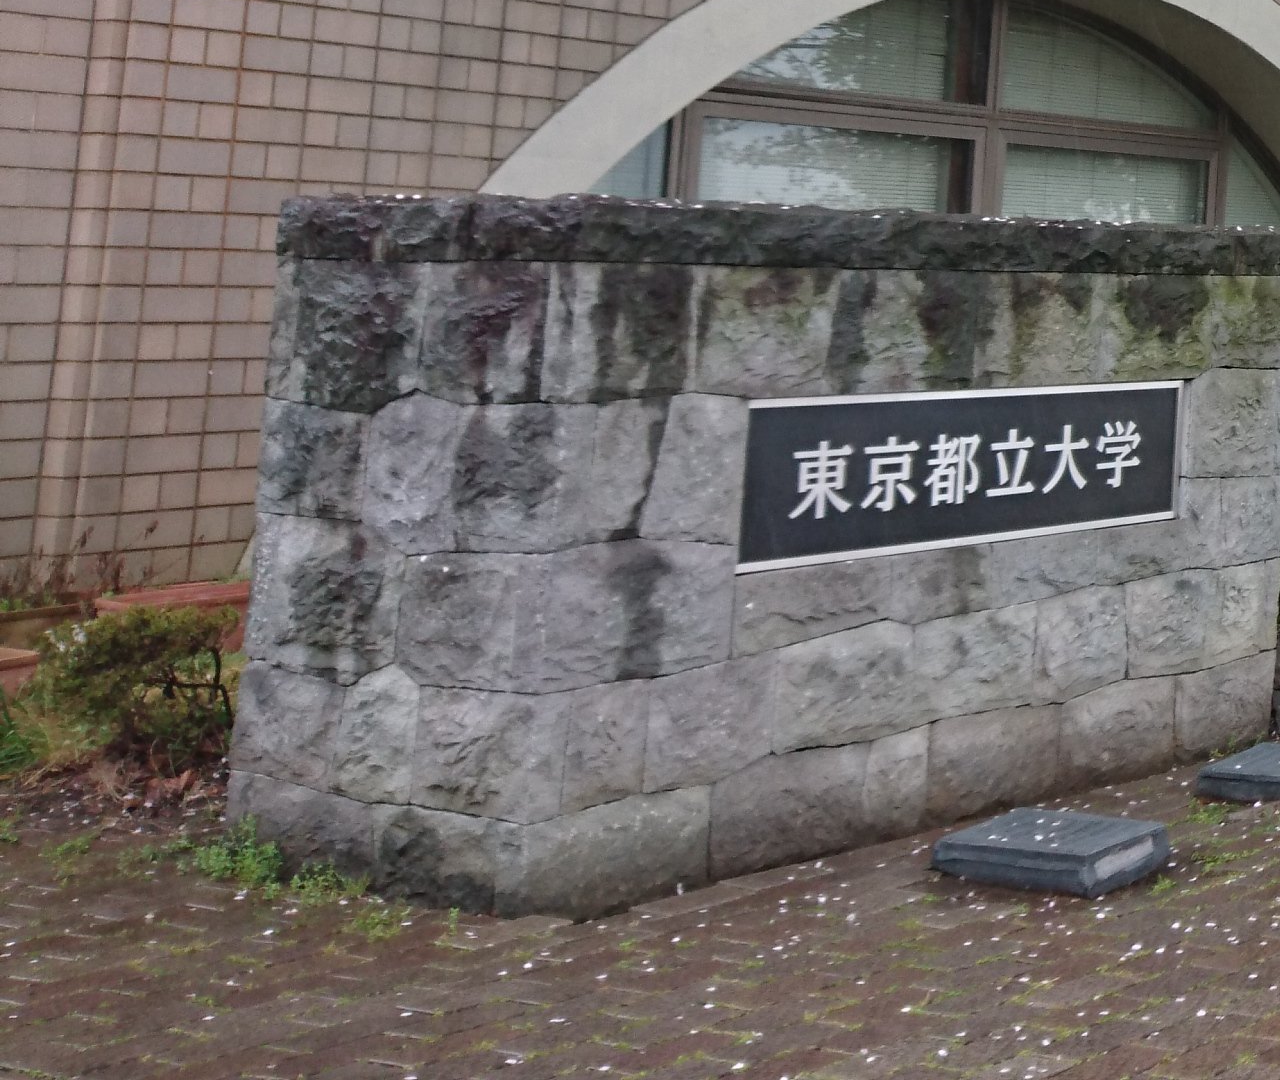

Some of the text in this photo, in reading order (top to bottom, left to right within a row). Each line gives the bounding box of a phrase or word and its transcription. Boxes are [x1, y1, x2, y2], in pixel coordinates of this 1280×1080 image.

[789, 421, 1141, 519] 東京都立大学
